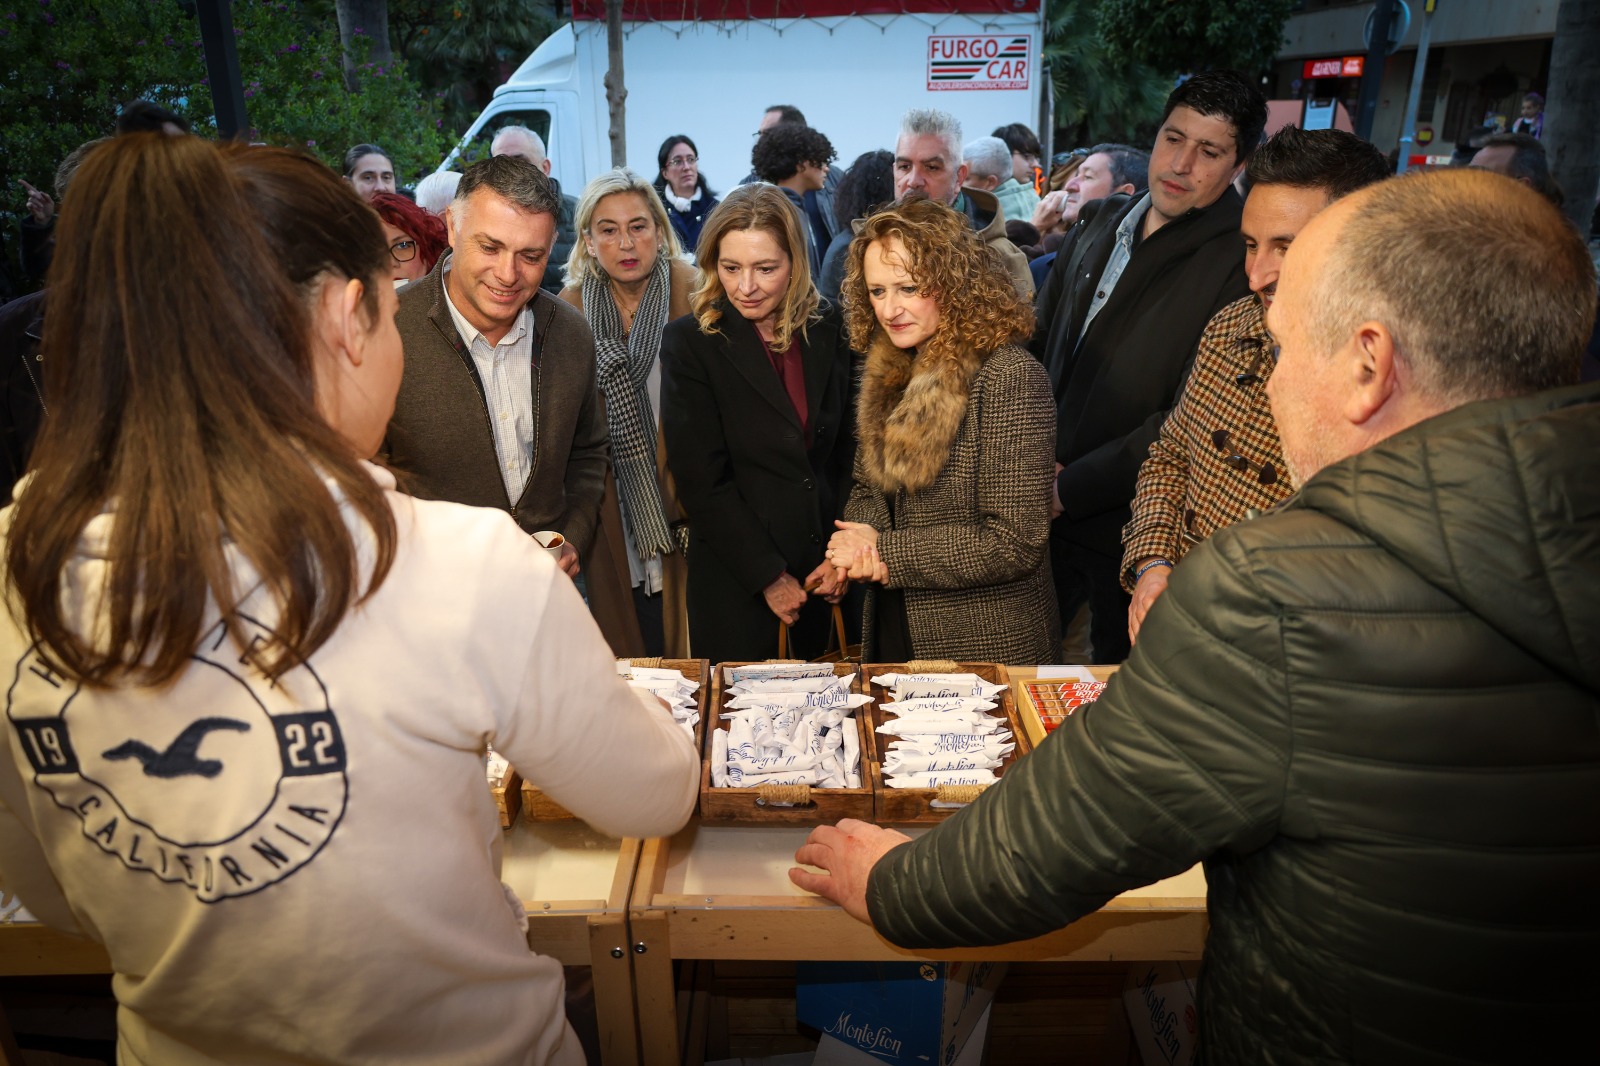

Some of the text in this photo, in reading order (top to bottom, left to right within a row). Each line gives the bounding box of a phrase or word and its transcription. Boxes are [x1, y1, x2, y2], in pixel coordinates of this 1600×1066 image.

[931, 39, 998, 58] FURGO
[986, 60, 1026, 79] CAR
[25, 721, 337, 768] 19 22
[79, 795, 330, 892] CALIFORNIA
